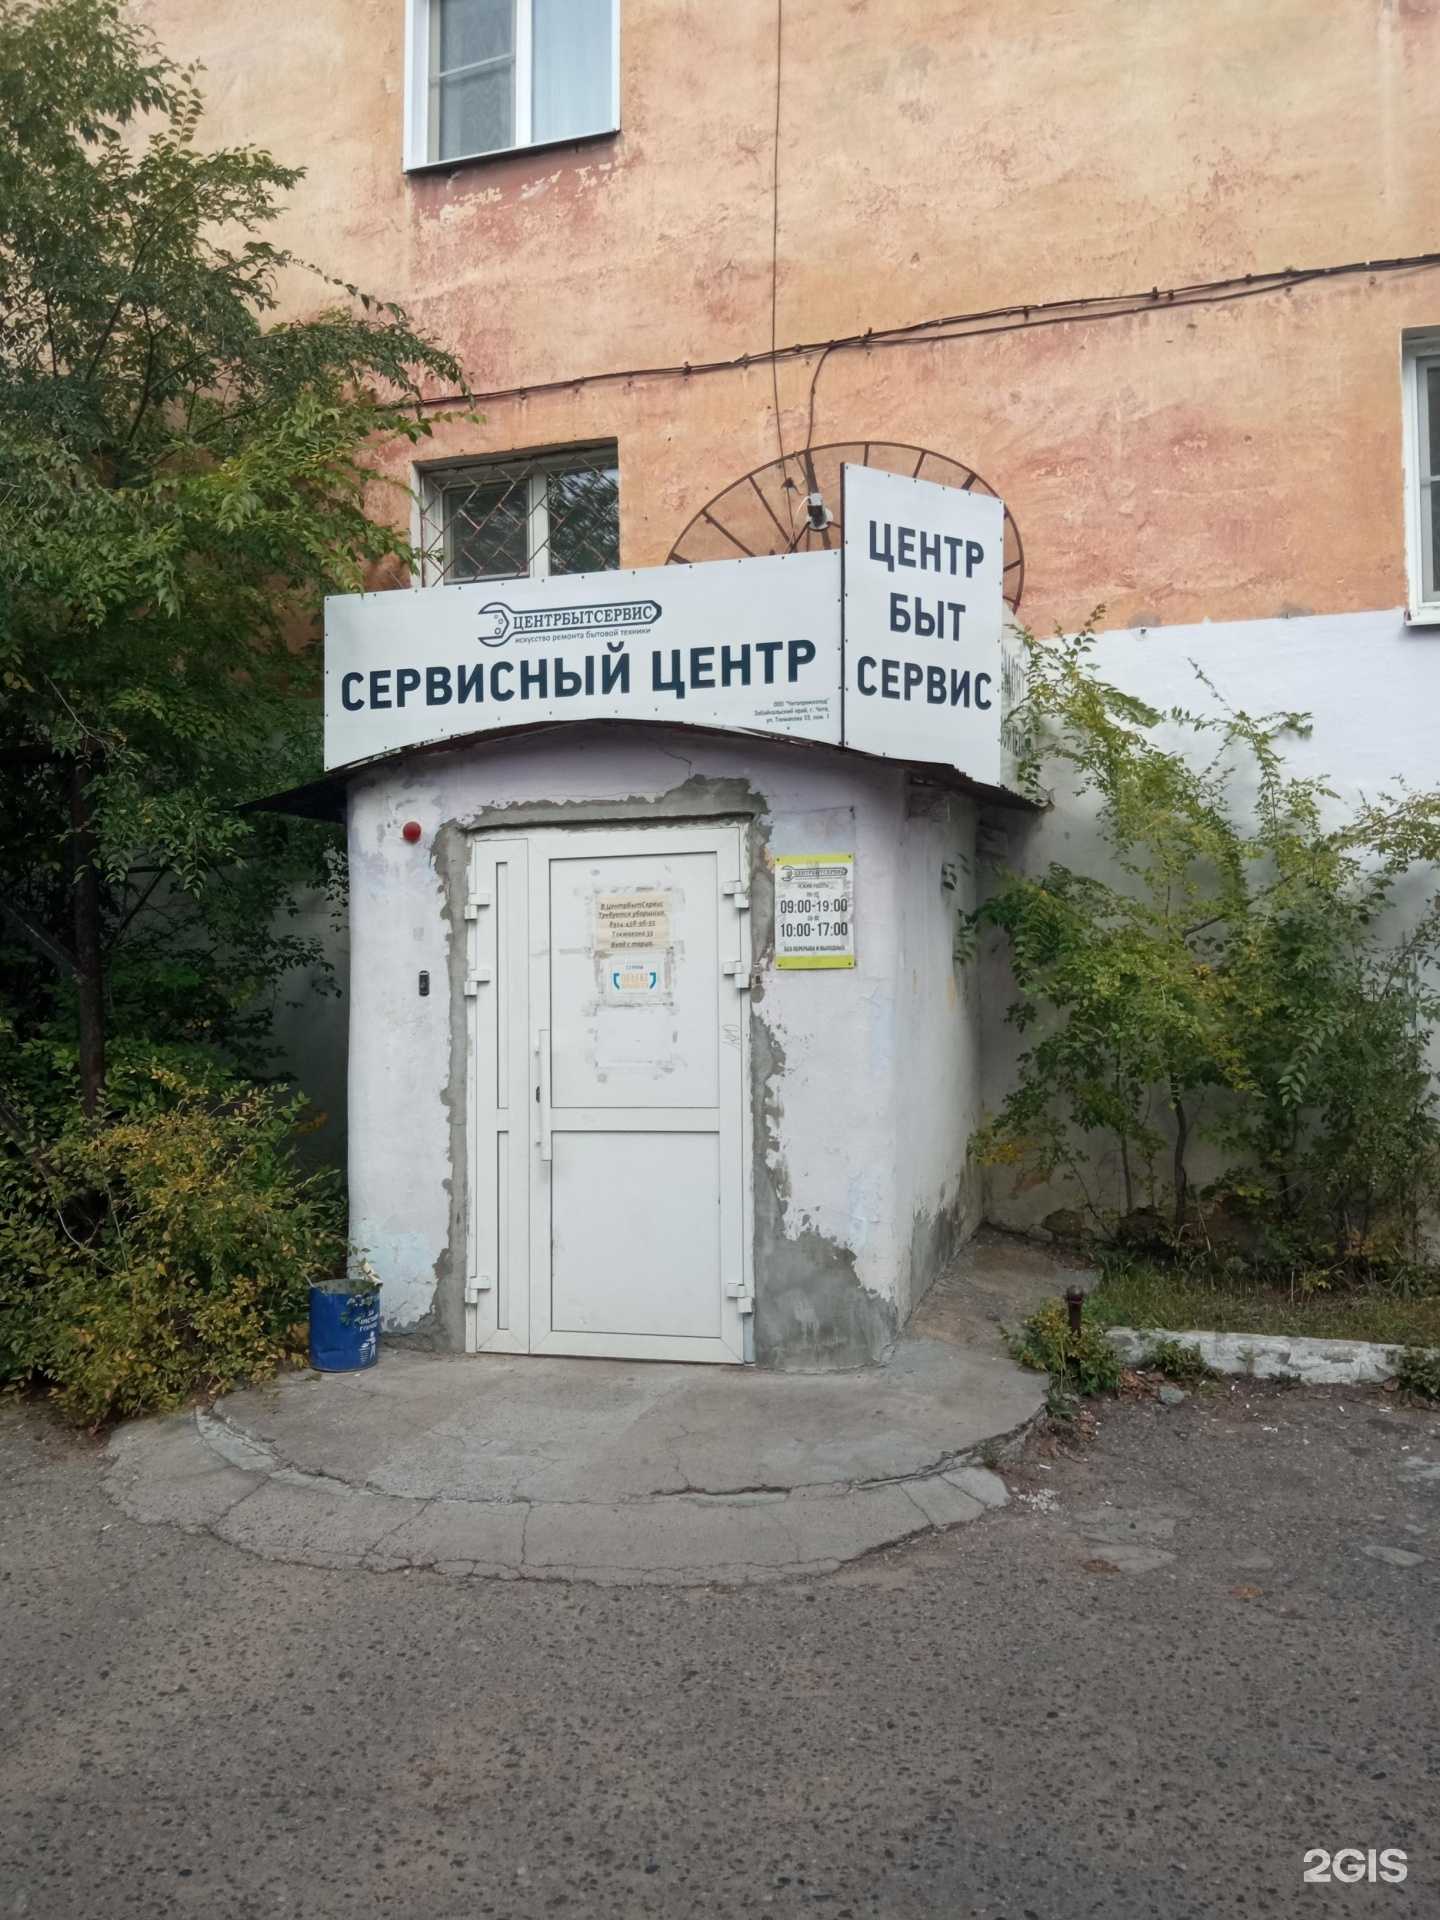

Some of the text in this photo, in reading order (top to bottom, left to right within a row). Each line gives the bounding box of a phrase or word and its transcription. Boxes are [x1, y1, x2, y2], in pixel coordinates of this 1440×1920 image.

[867, 520, 986, 579] ЦЕНТР
[513, 605, 652, 630] ЦЕНТРБЫТСЕРВИС
[888, 592, 967, 642] БЫТ
[515, 627, 652, 645] искусство ремонта бытовой техники
[341, 638, 818, 712] СЕРВИСНЫЙ ЦЕНТР
[856, 655, 992, 711] СЕРВИС
[780, 899, 848, 914] 09:00-19:00
[780, 922, 848, 937] 10:00-17:00
